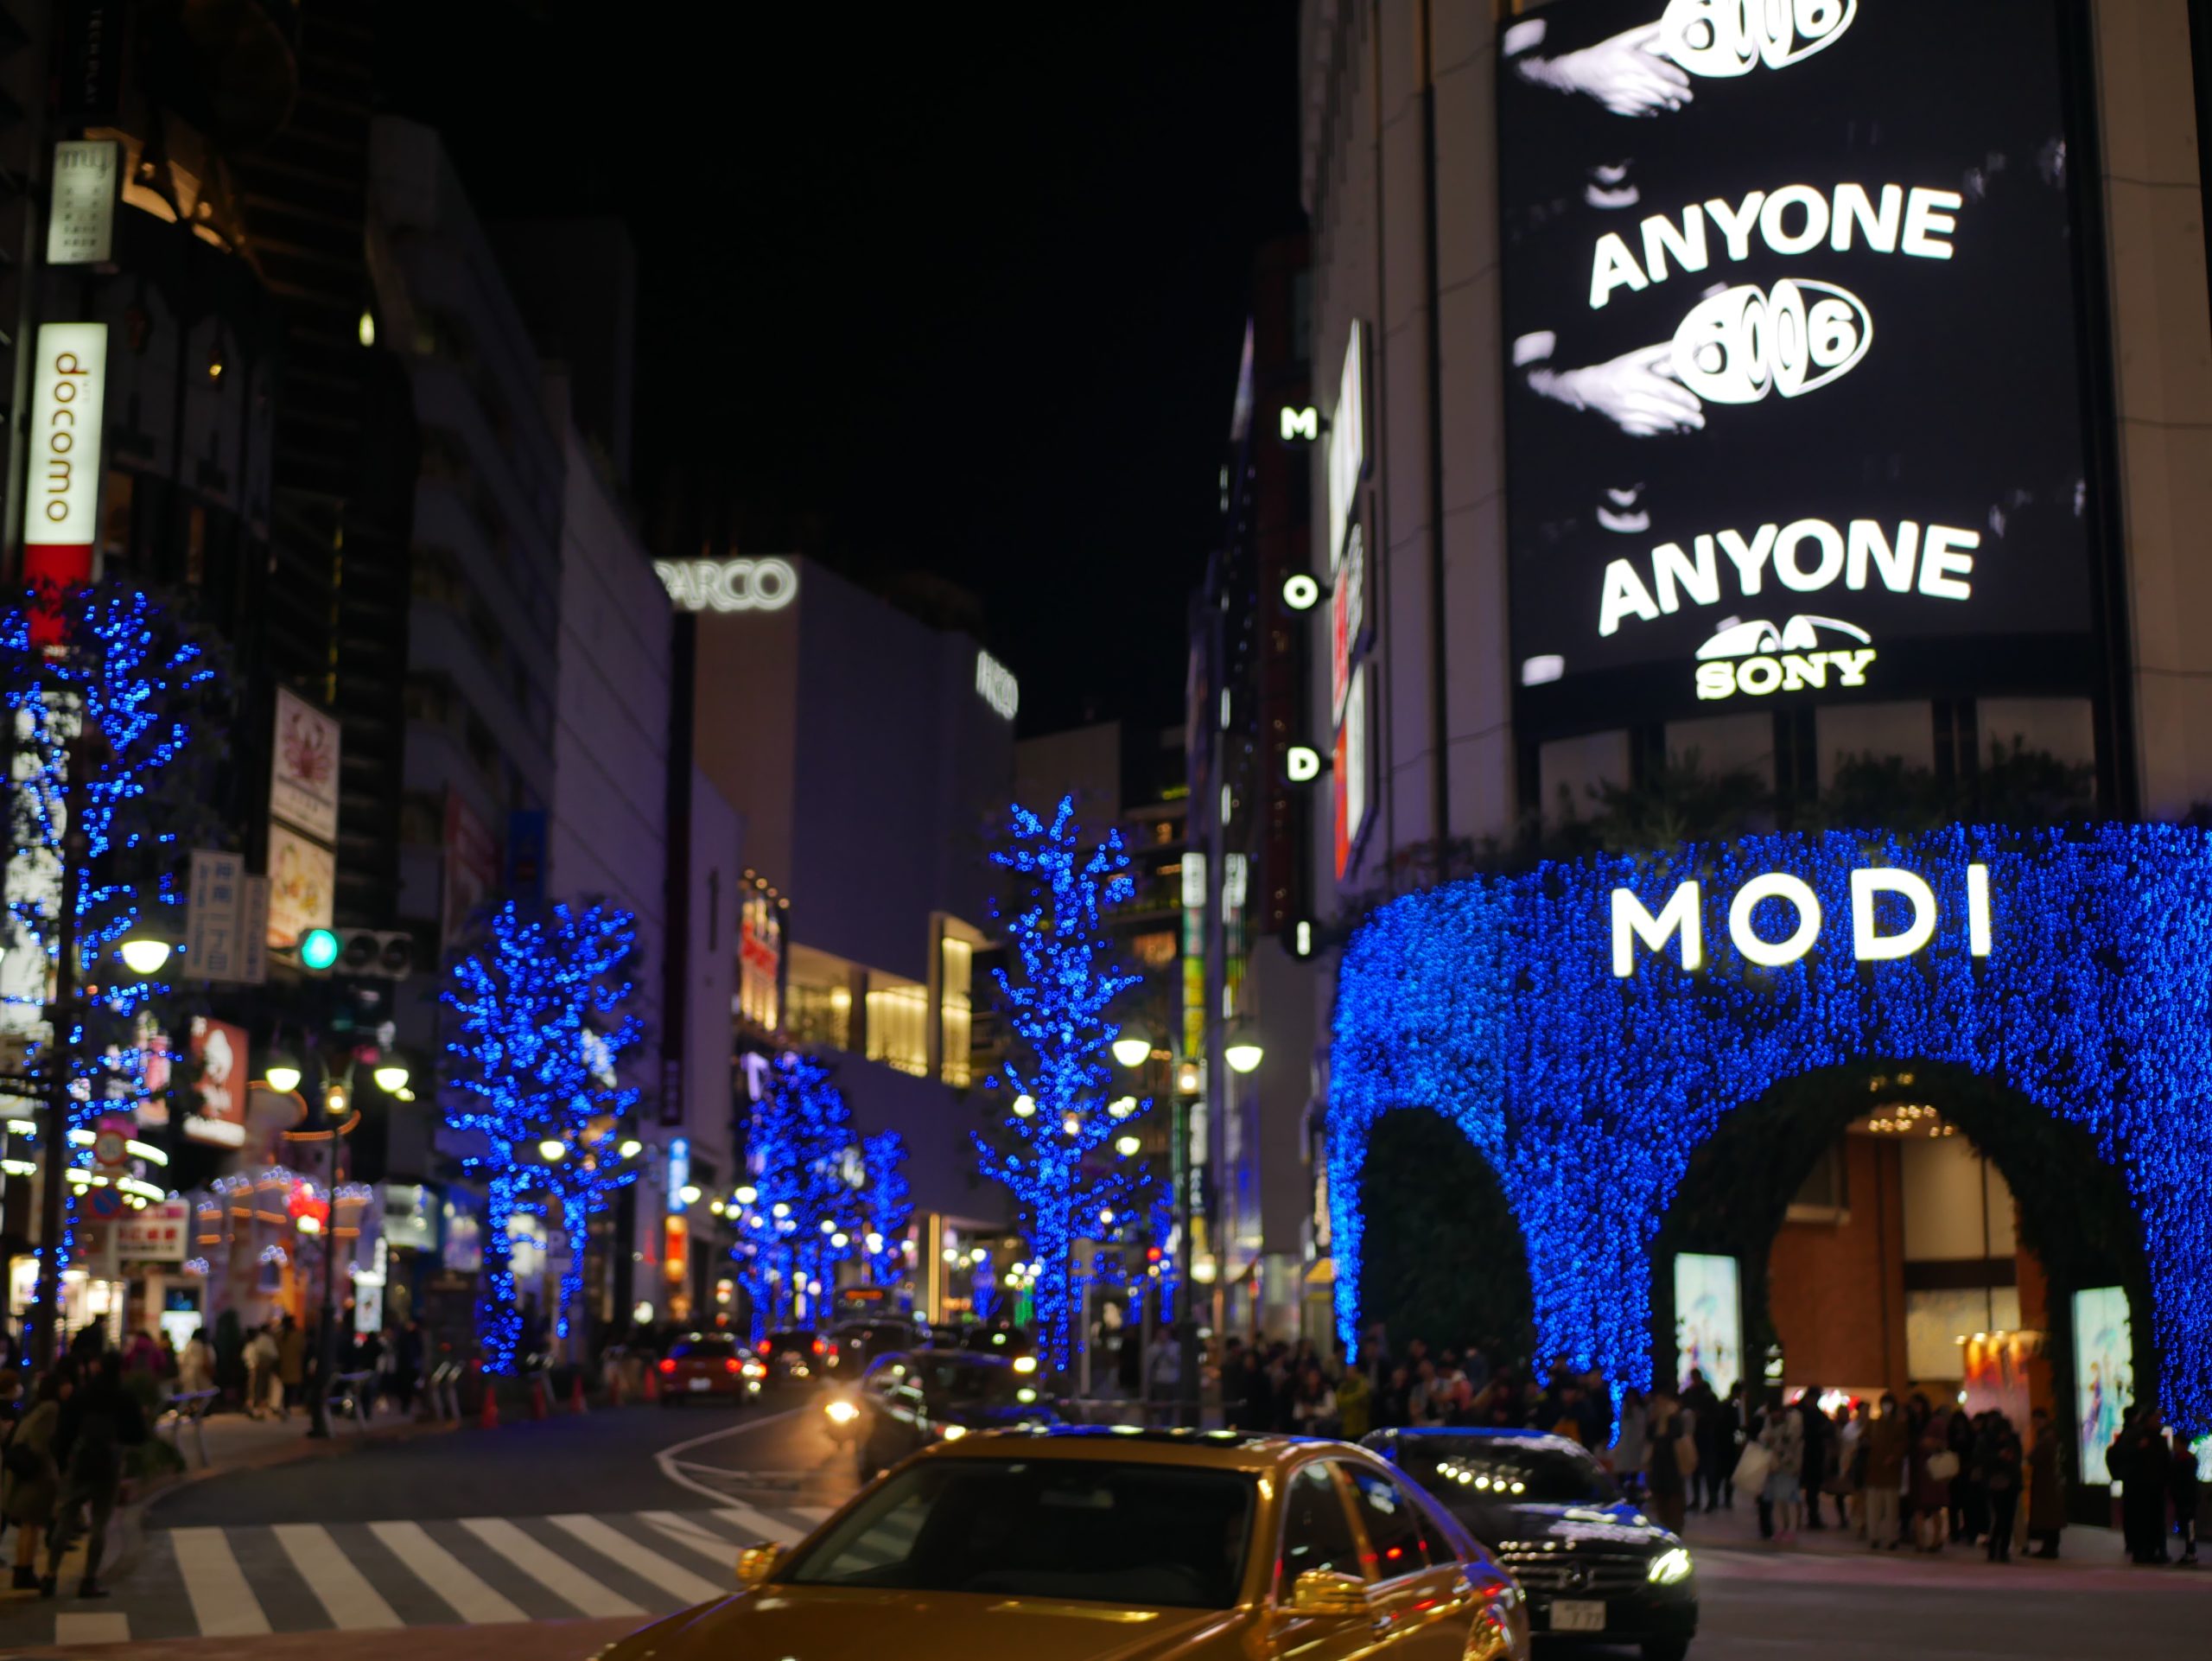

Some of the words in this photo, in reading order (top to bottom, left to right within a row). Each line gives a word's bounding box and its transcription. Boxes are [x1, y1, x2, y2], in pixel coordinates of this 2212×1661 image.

[1589, 183, 1962, 309] ANYONE
[47, 353, 90, 522] docomo
[1599, 519, 1980, 637] ANYONE
[1695, 648, 1877, 700] SONY
[1611, 863, 1991, 978] MODI
